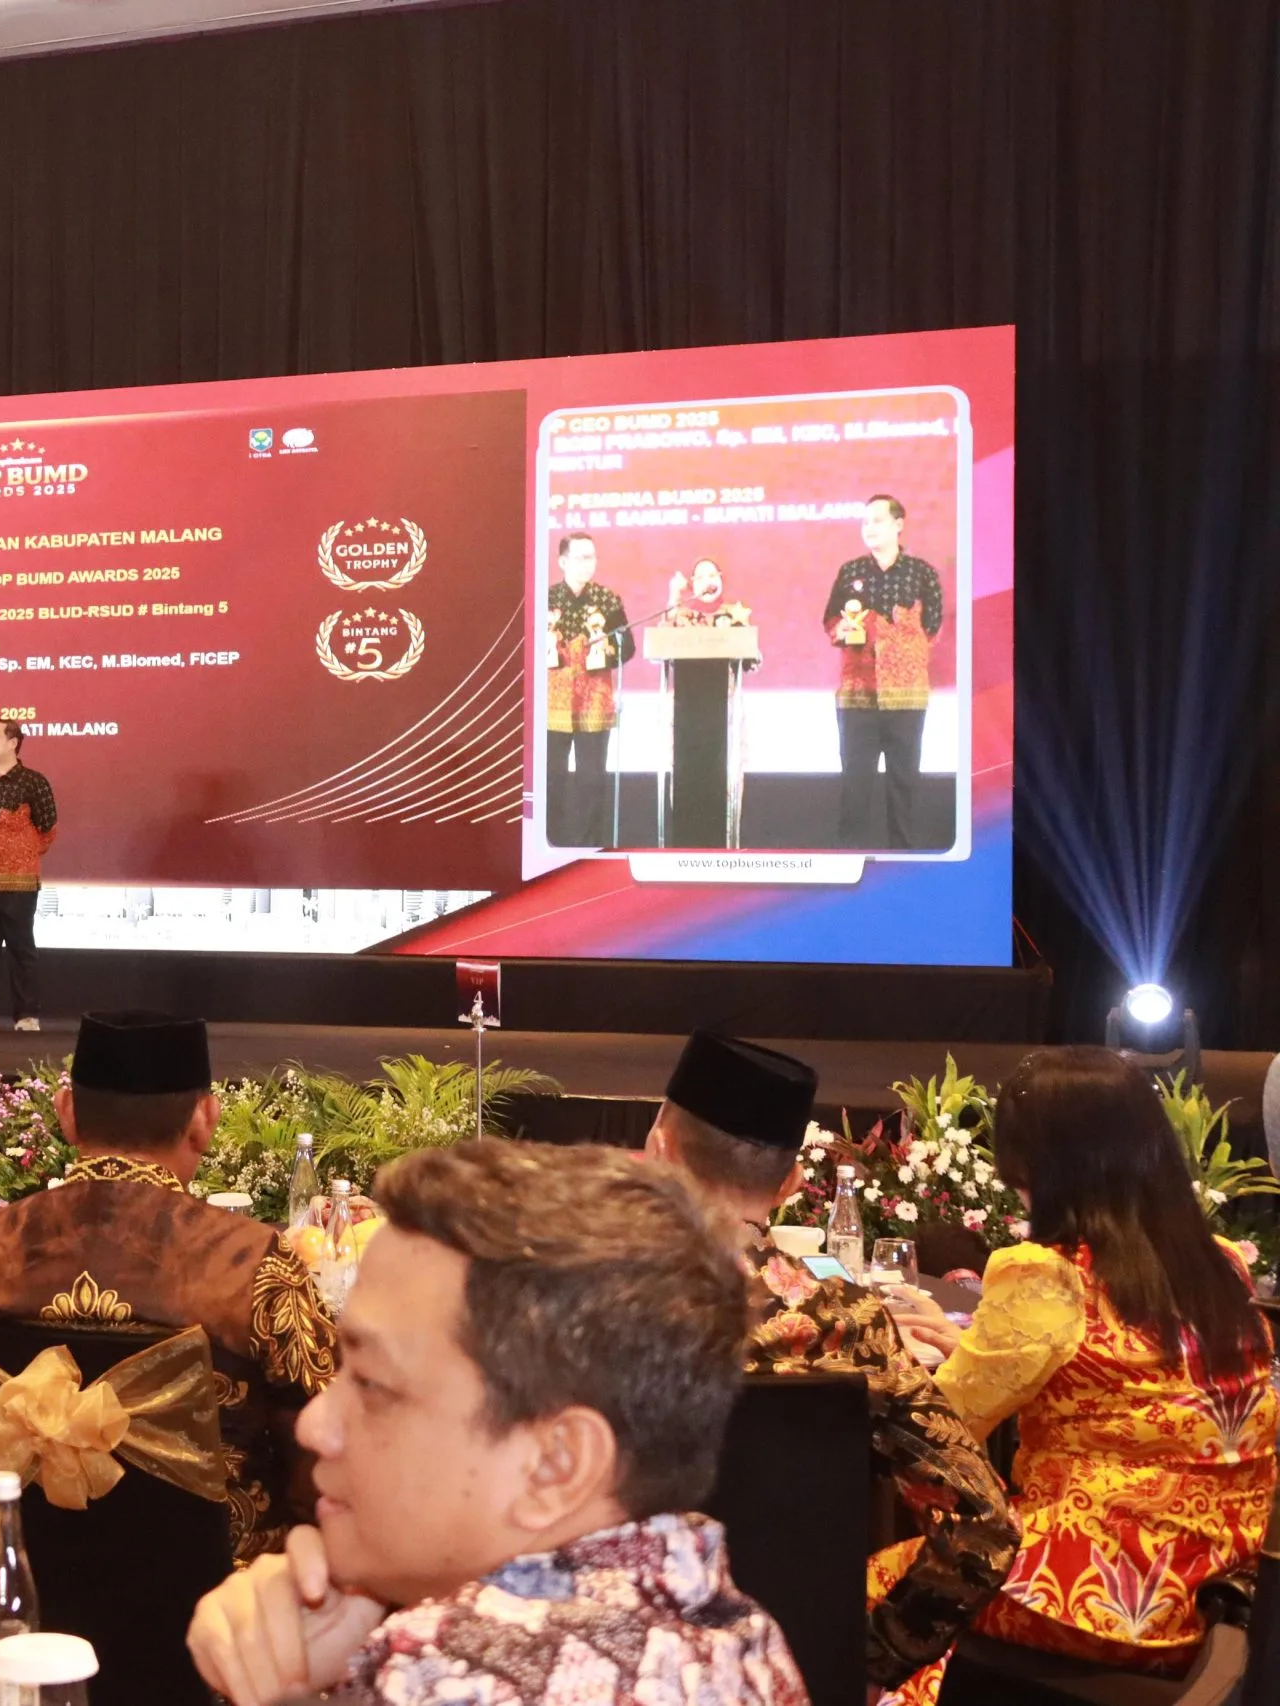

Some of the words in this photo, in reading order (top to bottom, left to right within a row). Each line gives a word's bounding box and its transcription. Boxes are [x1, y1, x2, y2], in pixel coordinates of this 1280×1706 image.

[569, 417, 611, 433] CEO
[7, 463, 88, 485] BUMD
[33, 484, 75, 496] 2025
[24, 531, 135, 549] KABUPATEN
[140, 527, 222, 545] MALANG
[335, 542, 409, 557] GOLDEN
[345, 558, 398, 570] TROPHY
[16, 571, 64, 586] BUMD
[68, 568, 139, 584] AWARDS
[142, 567, 181, 581] 2025
[38, 604, 134, 620] BLUD-RSUD
[138, 604, 148, 616] #
[151, 602, 214, 616] Bintang
[218, 601, 229, 613] 5
[342, 626, 398, 638] BINTANG
[26, 656, 55, 671] EM,
[59, 655, 98, 670] KEC,
[189, 651, 240, 666] FICEP
[0, 706, 36, 720] 2025
[47, 721, 119, 736] MALANG
[678, 857, 813, 870] www.topbusiness.id
